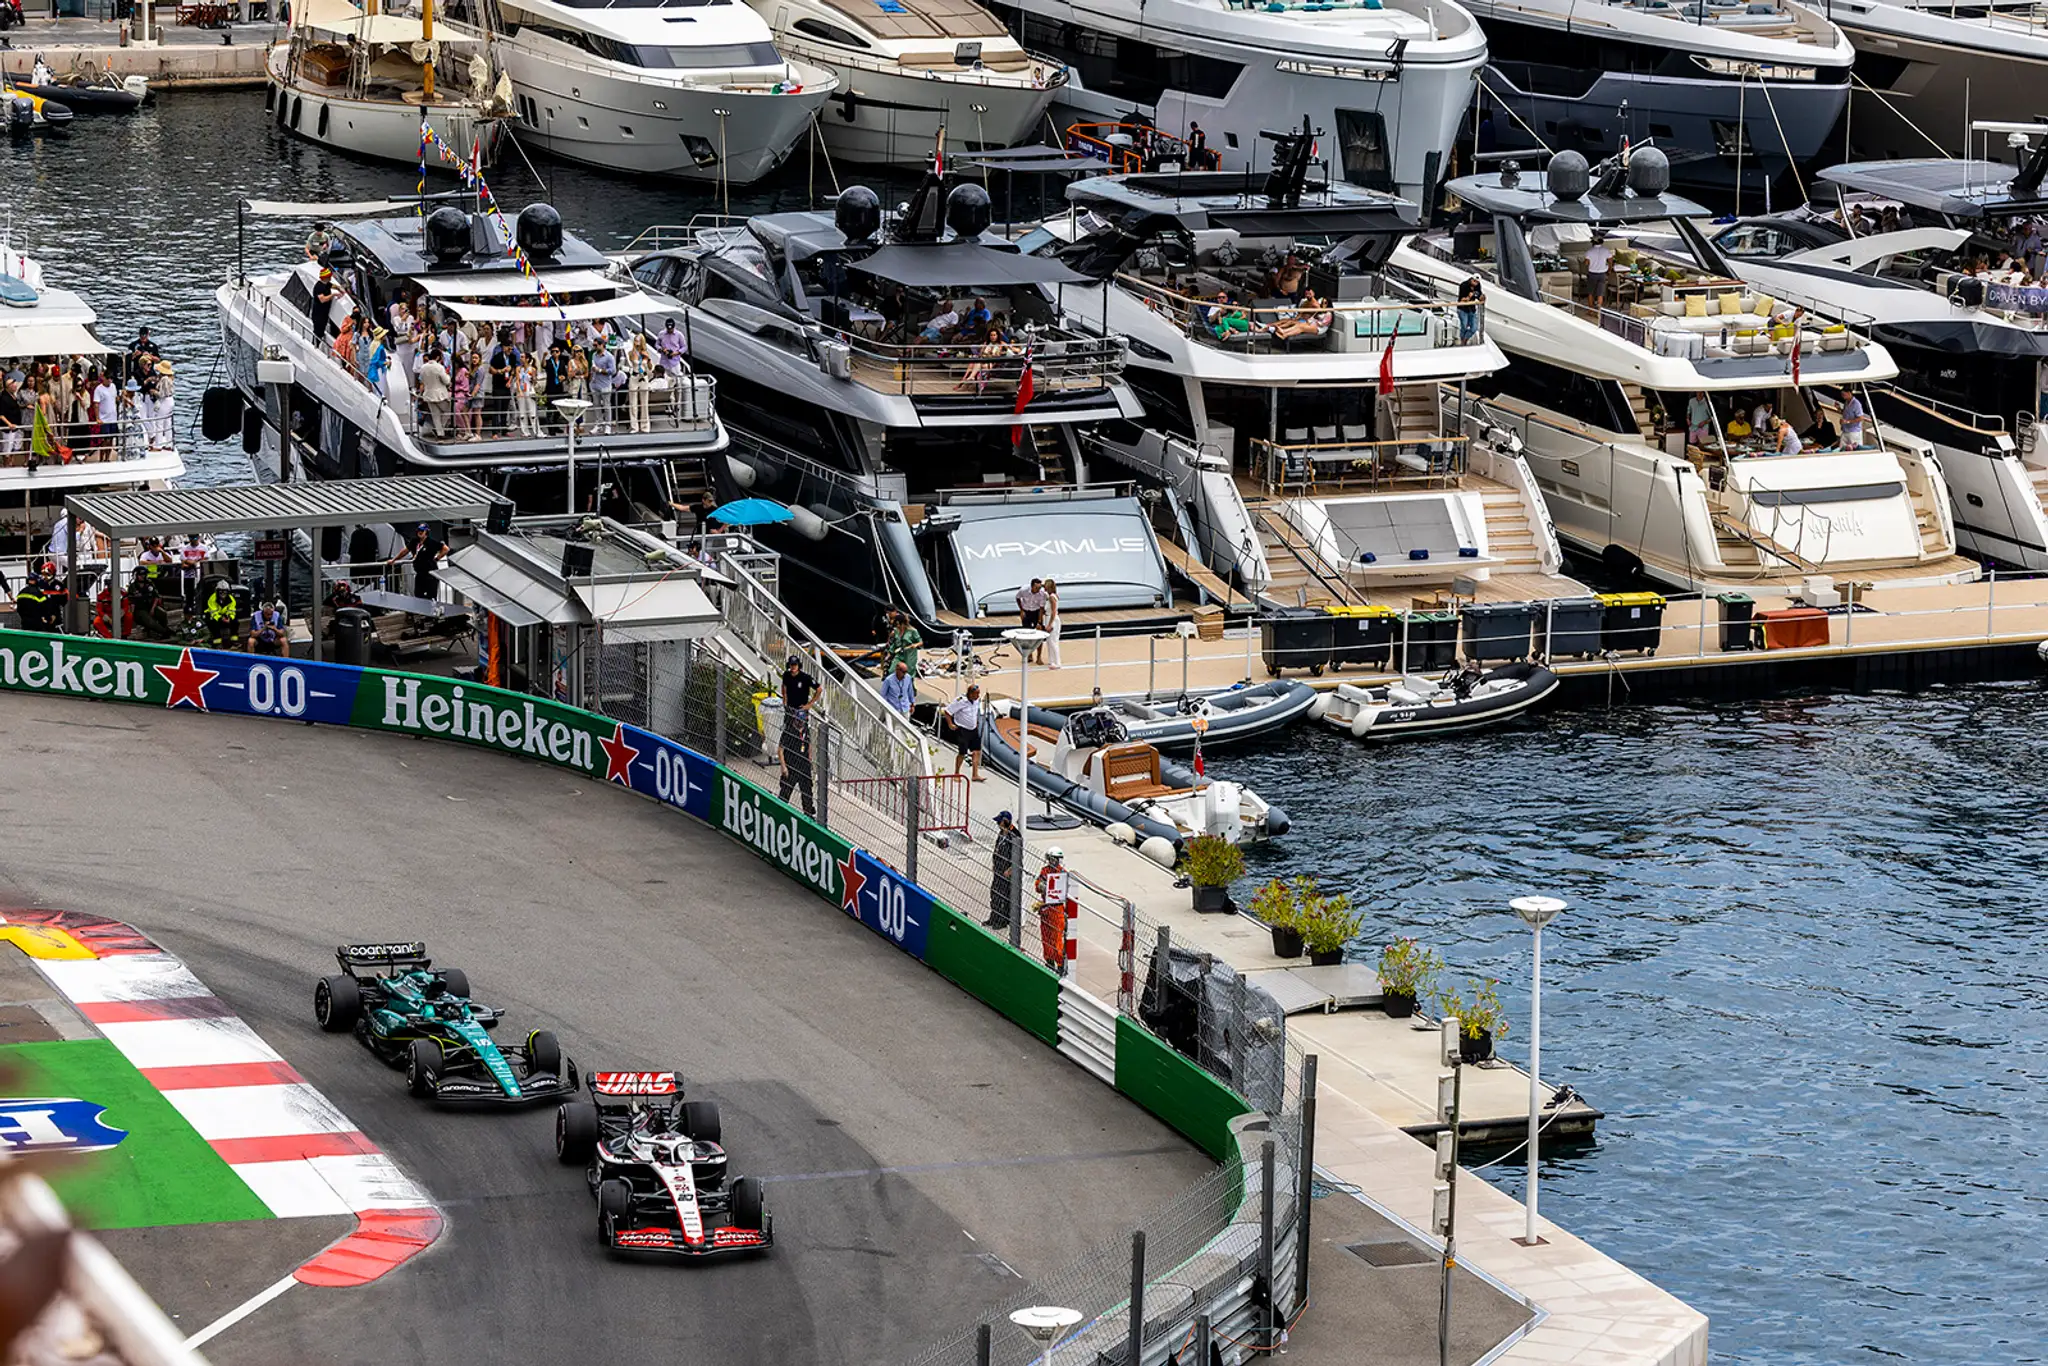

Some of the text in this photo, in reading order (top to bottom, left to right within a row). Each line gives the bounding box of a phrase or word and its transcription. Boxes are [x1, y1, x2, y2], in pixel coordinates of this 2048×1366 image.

[1989, 289, 2047, 307] DRIVEN BY
[963, 537, 1145, 561] MAXIMUS
[249, 663, 306, 715] 0.0
[381, 675, 689, 807] Heineken 0.0
[1130, 729, 1164, 738] WILLIAMS
[722, 775, 906, 942] Heineken 0.0
[350, 942, 417, 960] cognizant
[442, 1084, 481, 1093] aramco
[596, 1072, 676, 1093] HAAS
[619, 1229, 758, 1245] Money Gram
